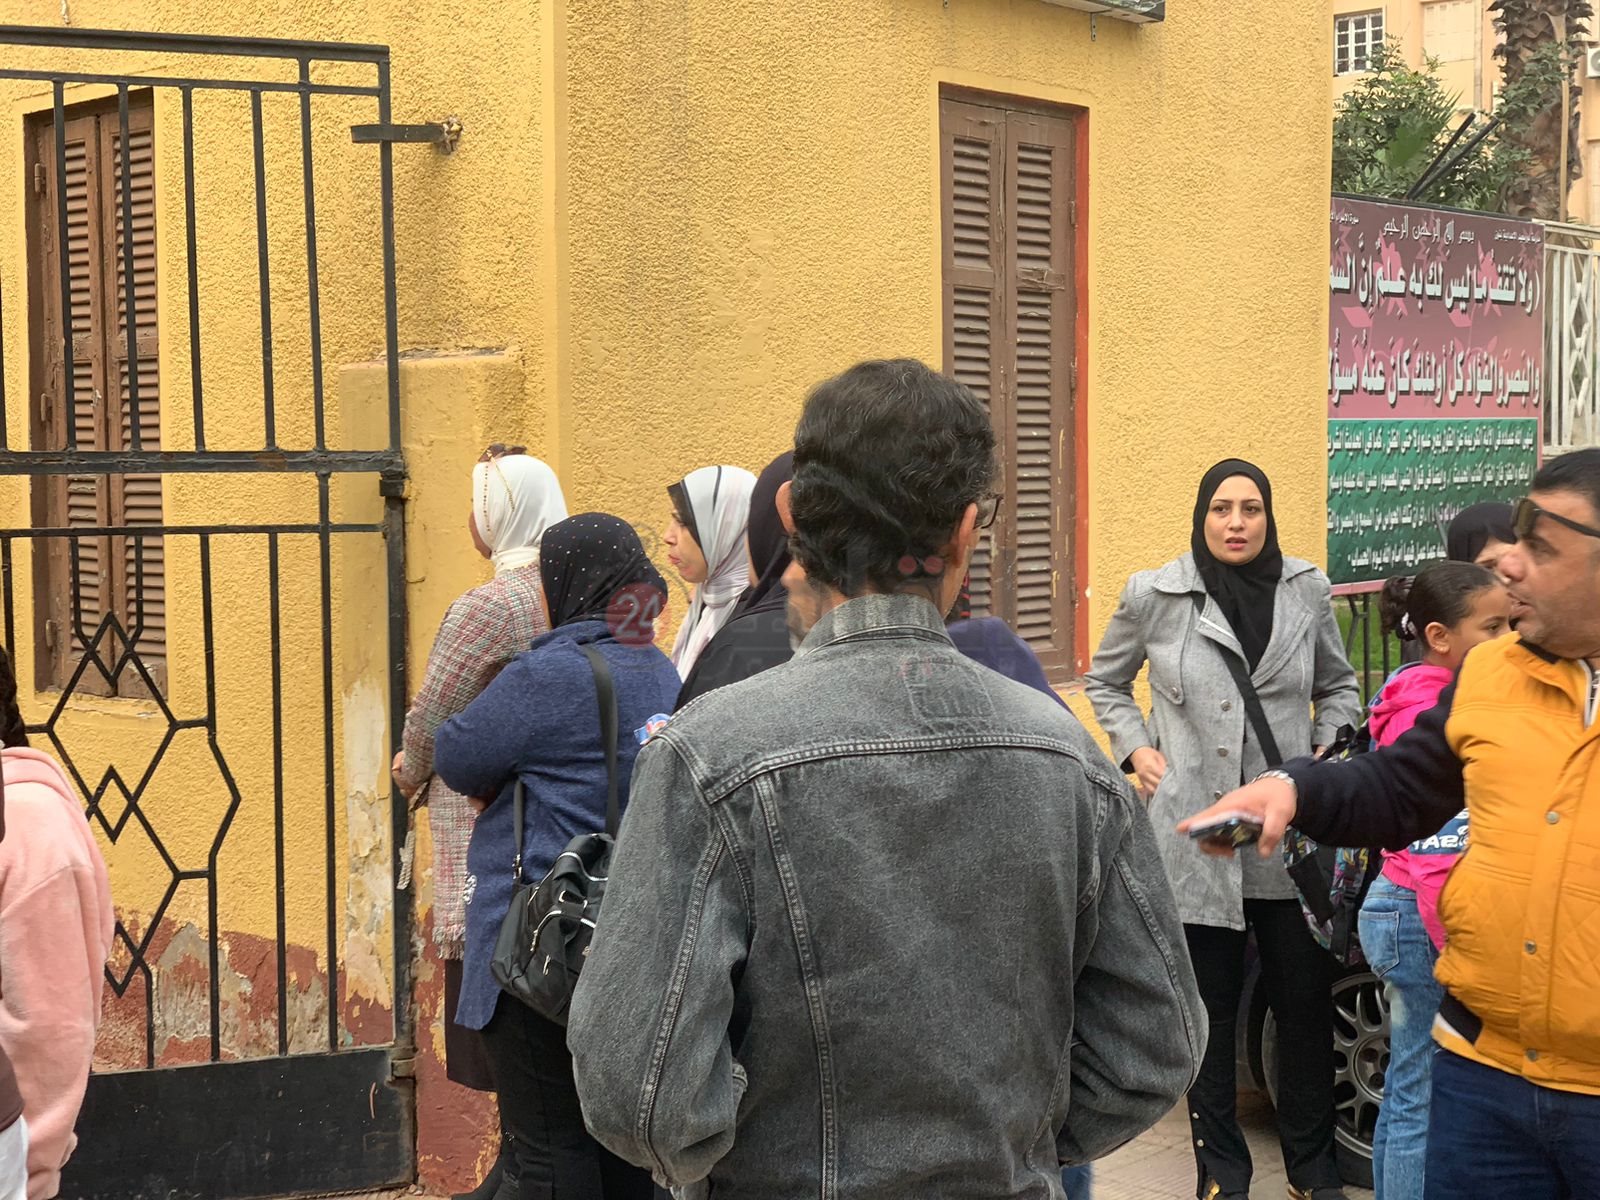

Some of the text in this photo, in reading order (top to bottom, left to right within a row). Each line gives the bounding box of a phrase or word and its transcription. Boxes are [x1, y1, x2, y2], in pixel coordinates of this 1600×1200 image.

[1382, 212, 1409, 239] الرحيم
[1412, 217, 1441, 243] الرحمن
[1457, 231, 1475, 244] بسم
